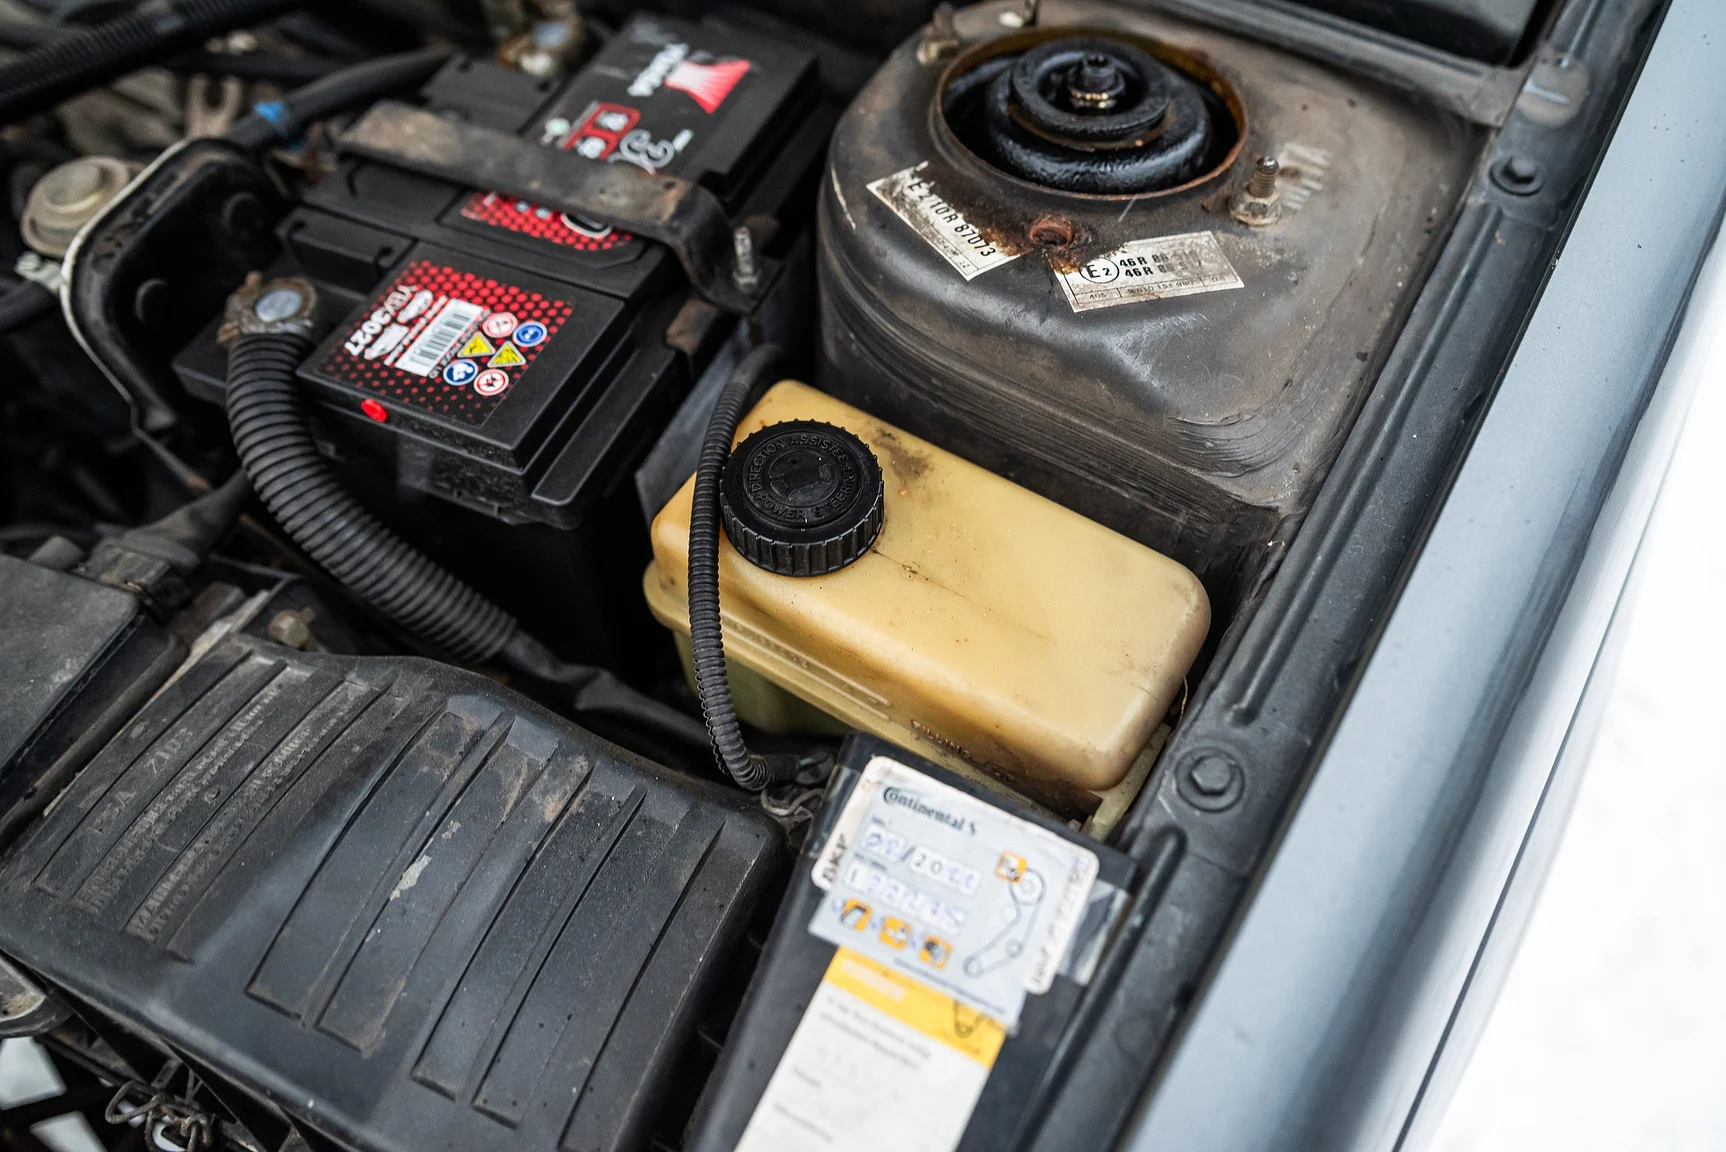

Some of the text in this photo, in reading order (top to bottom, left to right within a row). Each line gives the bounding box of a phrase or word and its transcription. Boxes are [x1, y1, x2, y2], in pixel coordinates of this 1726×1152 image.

[908, 180, 923, 193] E
[954, 224, 996, 257] 87073
[750, 440, 786, 494] DIRECTION
[761, 493, 807, 519] POWER
[883, 786, 964, 832] Continental
